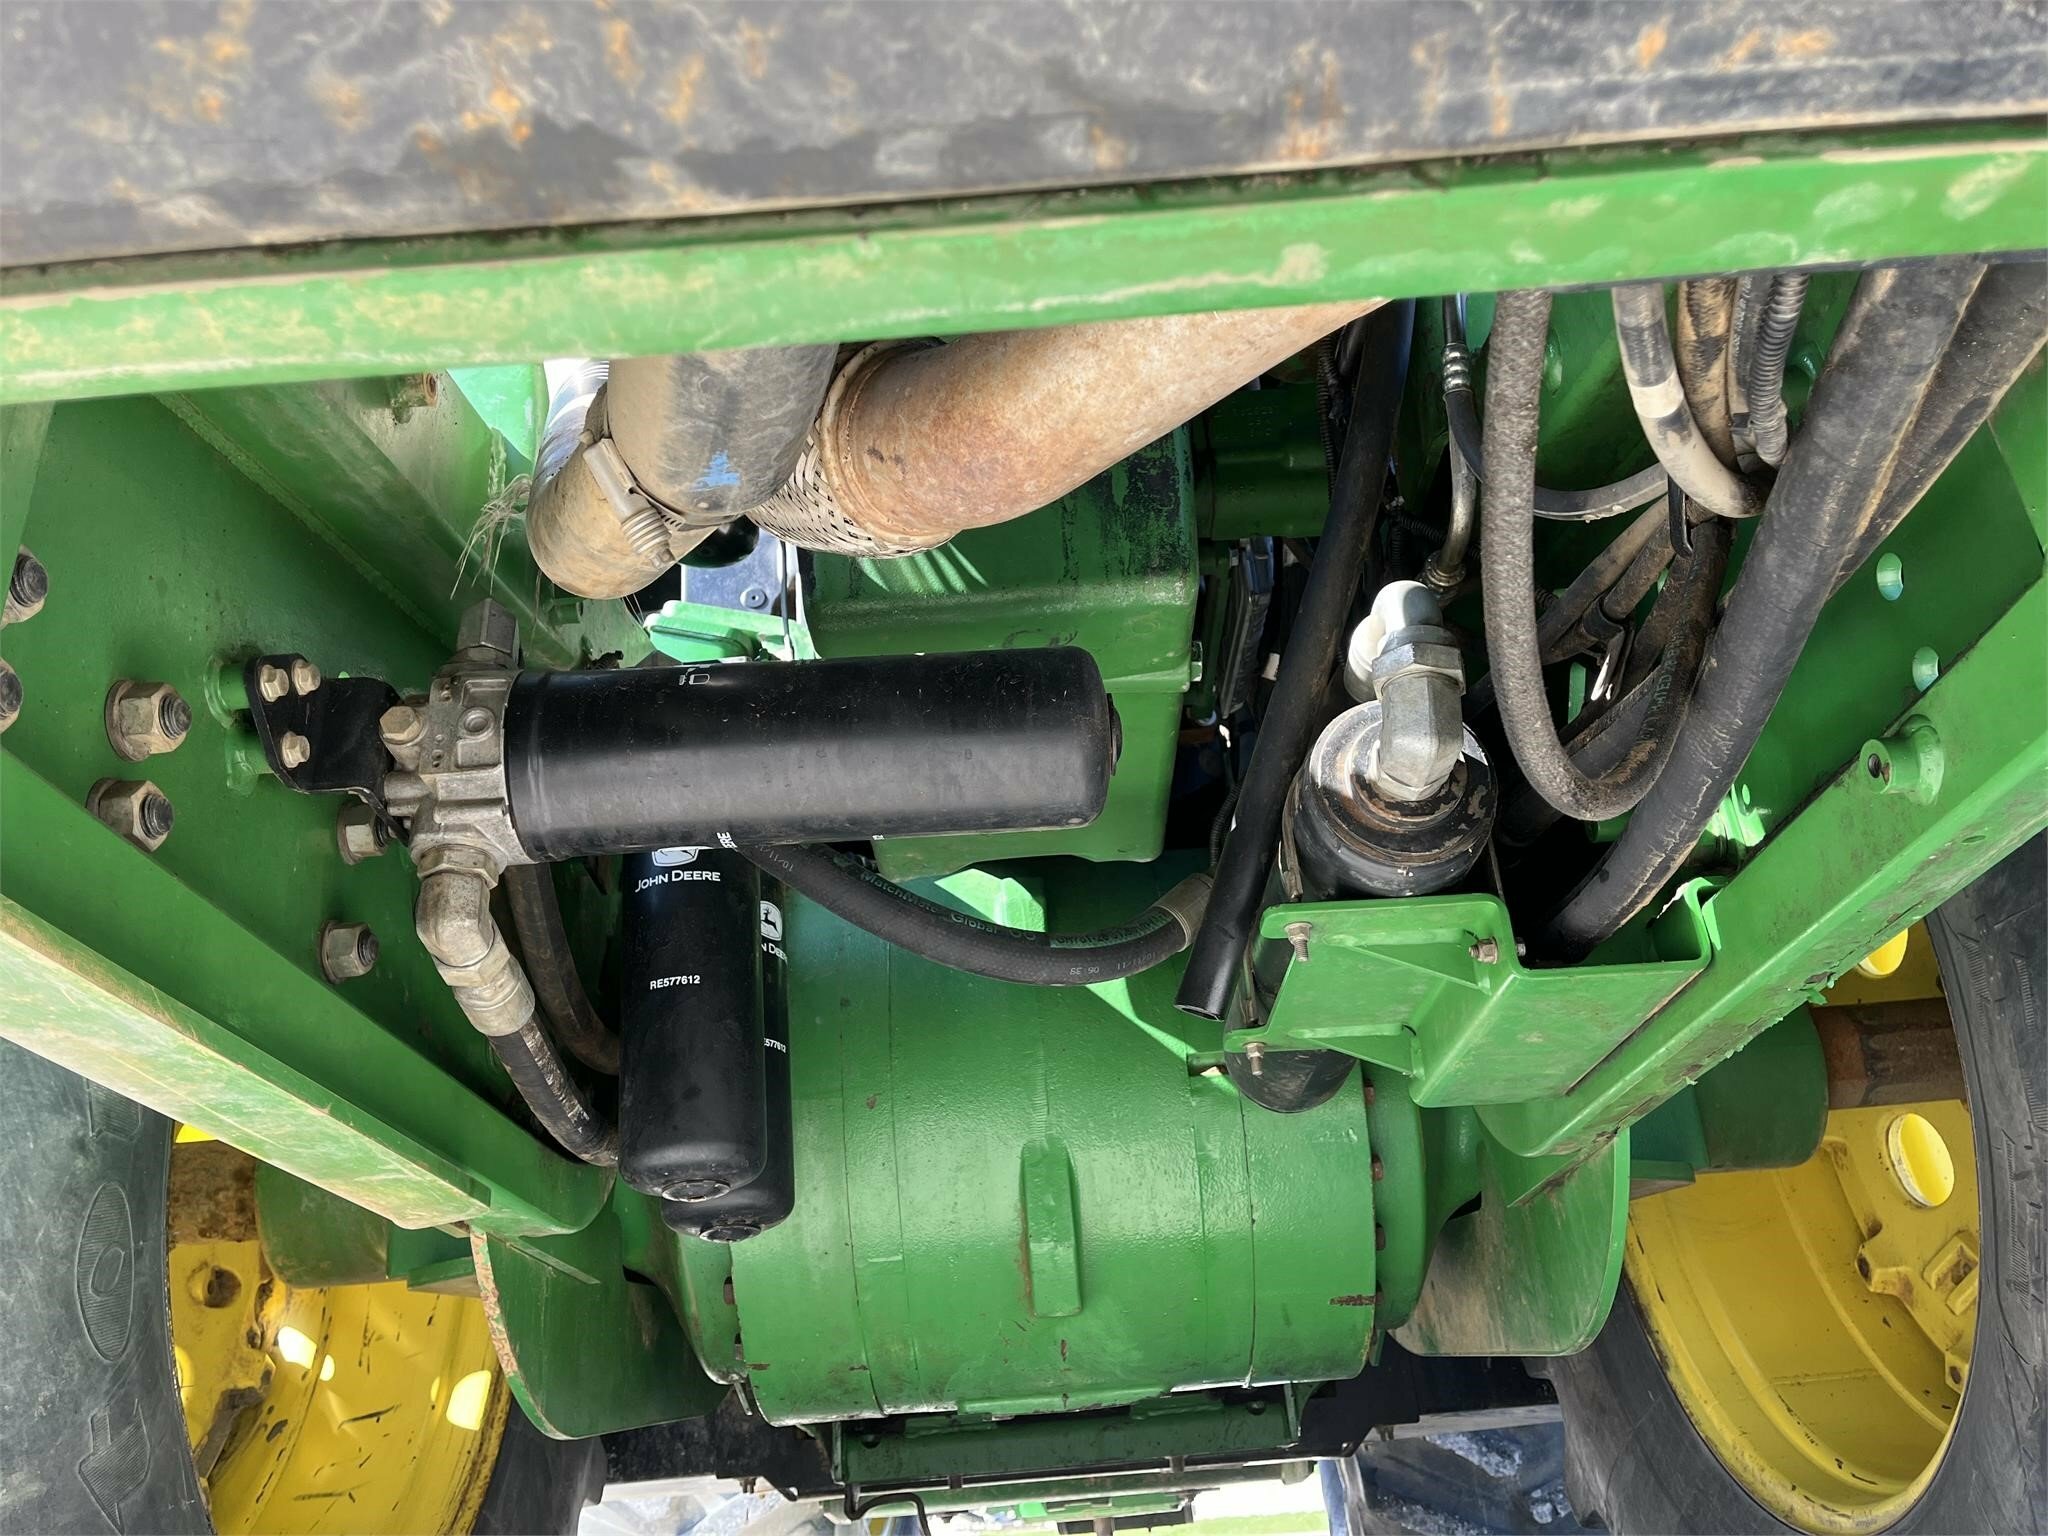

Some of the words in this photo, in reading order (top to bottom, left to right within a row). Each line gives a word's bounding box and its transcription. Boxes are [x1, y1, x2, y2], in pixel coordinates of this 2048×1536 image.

[716, 831, 738, 849] ERE
[635, 873, 669, 893] JOHN
[671, 870, 721, 882] DEERE
[951, 911, 998, 934] Global
[769, 943, 789, 965] DEE
[650, 975, 701, 990] RE577612
[763, 1037, 787, 1054] 577612
